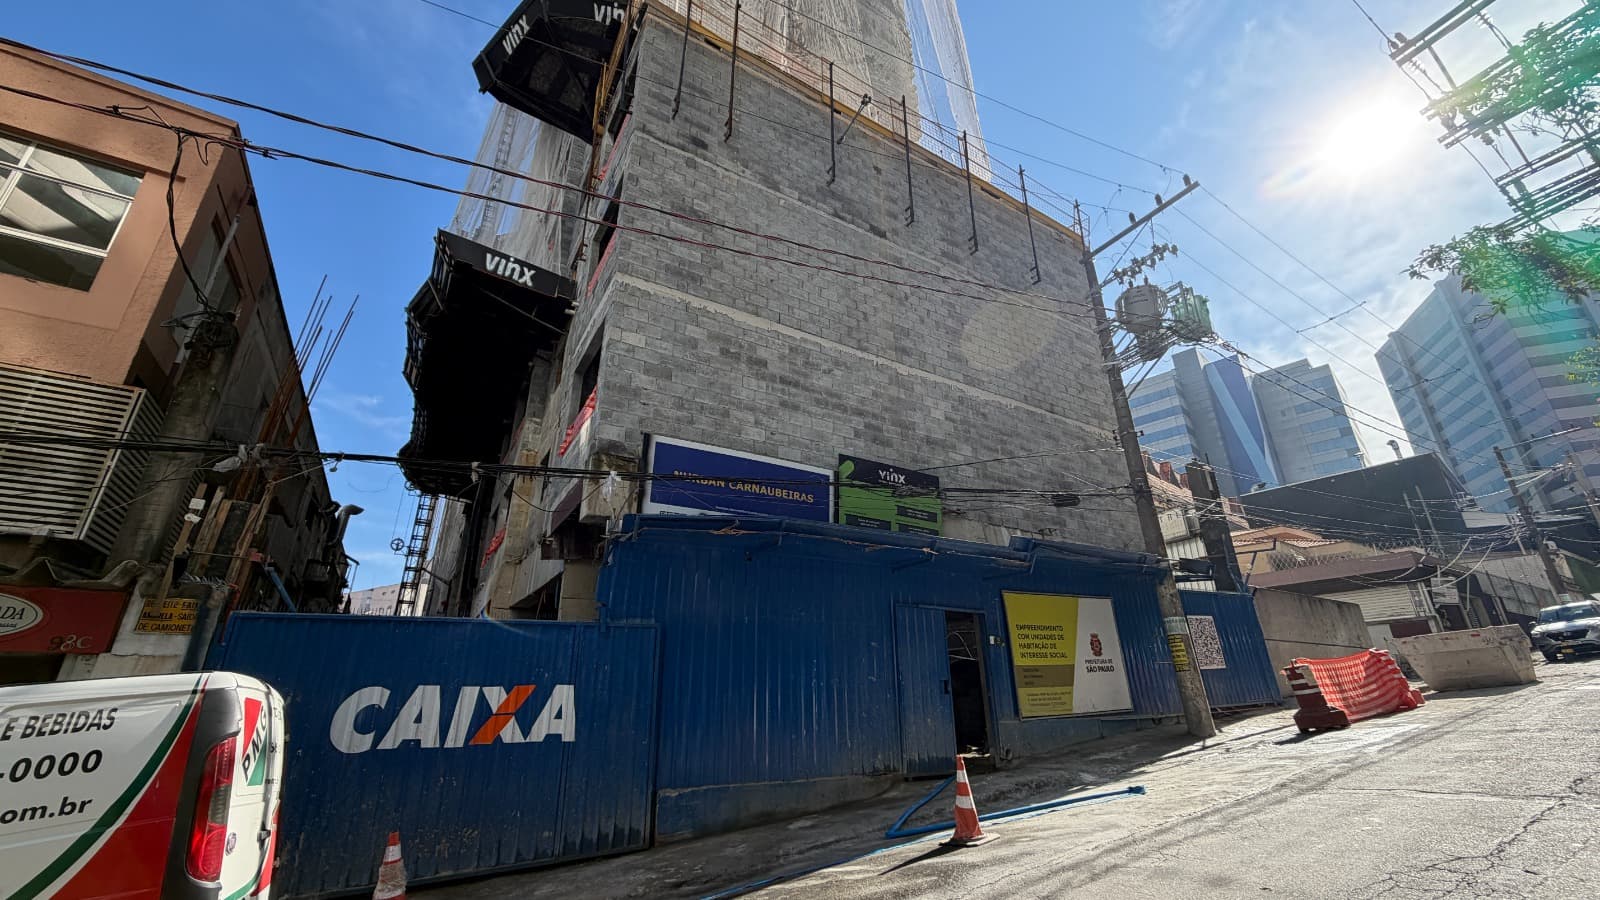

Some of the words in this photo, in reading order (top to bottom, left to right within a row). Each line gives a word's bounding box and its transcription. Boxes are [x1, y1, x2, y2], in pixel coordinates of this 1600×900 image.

[593, 2, 639, 31] vin
[486, 252, 537, 287] vinx
[728, 480, 814, 503] CARNAUBEIRAS
[0, 606, 26, 620] DA
[138, 622, 148, 631] DE
[150, 623, 193, 632] CAMIONET
[1015, 624, 1064, 632] EMPREENDIMENTO
[1018, 633, 1031, 641] COM
[1031, 633, 1057, 641] UNIDADES
[1057, 633, 1065, 641] DE
[1019, 641, 1049, 650] HABITAÇÃO
[1050, 642, 1057, 650] DE
[1020, 651, 1049, 659] INTERESSE
[1049, 651, 1068, 659] SOCIAL
[1086, 665, 1098, 673] SÃO
[1097, 665, 1115, 673] PAULO
[0, 716, 19, 741] E
[20, 708, 119, 739] BEBIDAS
[329, 684, 576, 754] CAIXA
